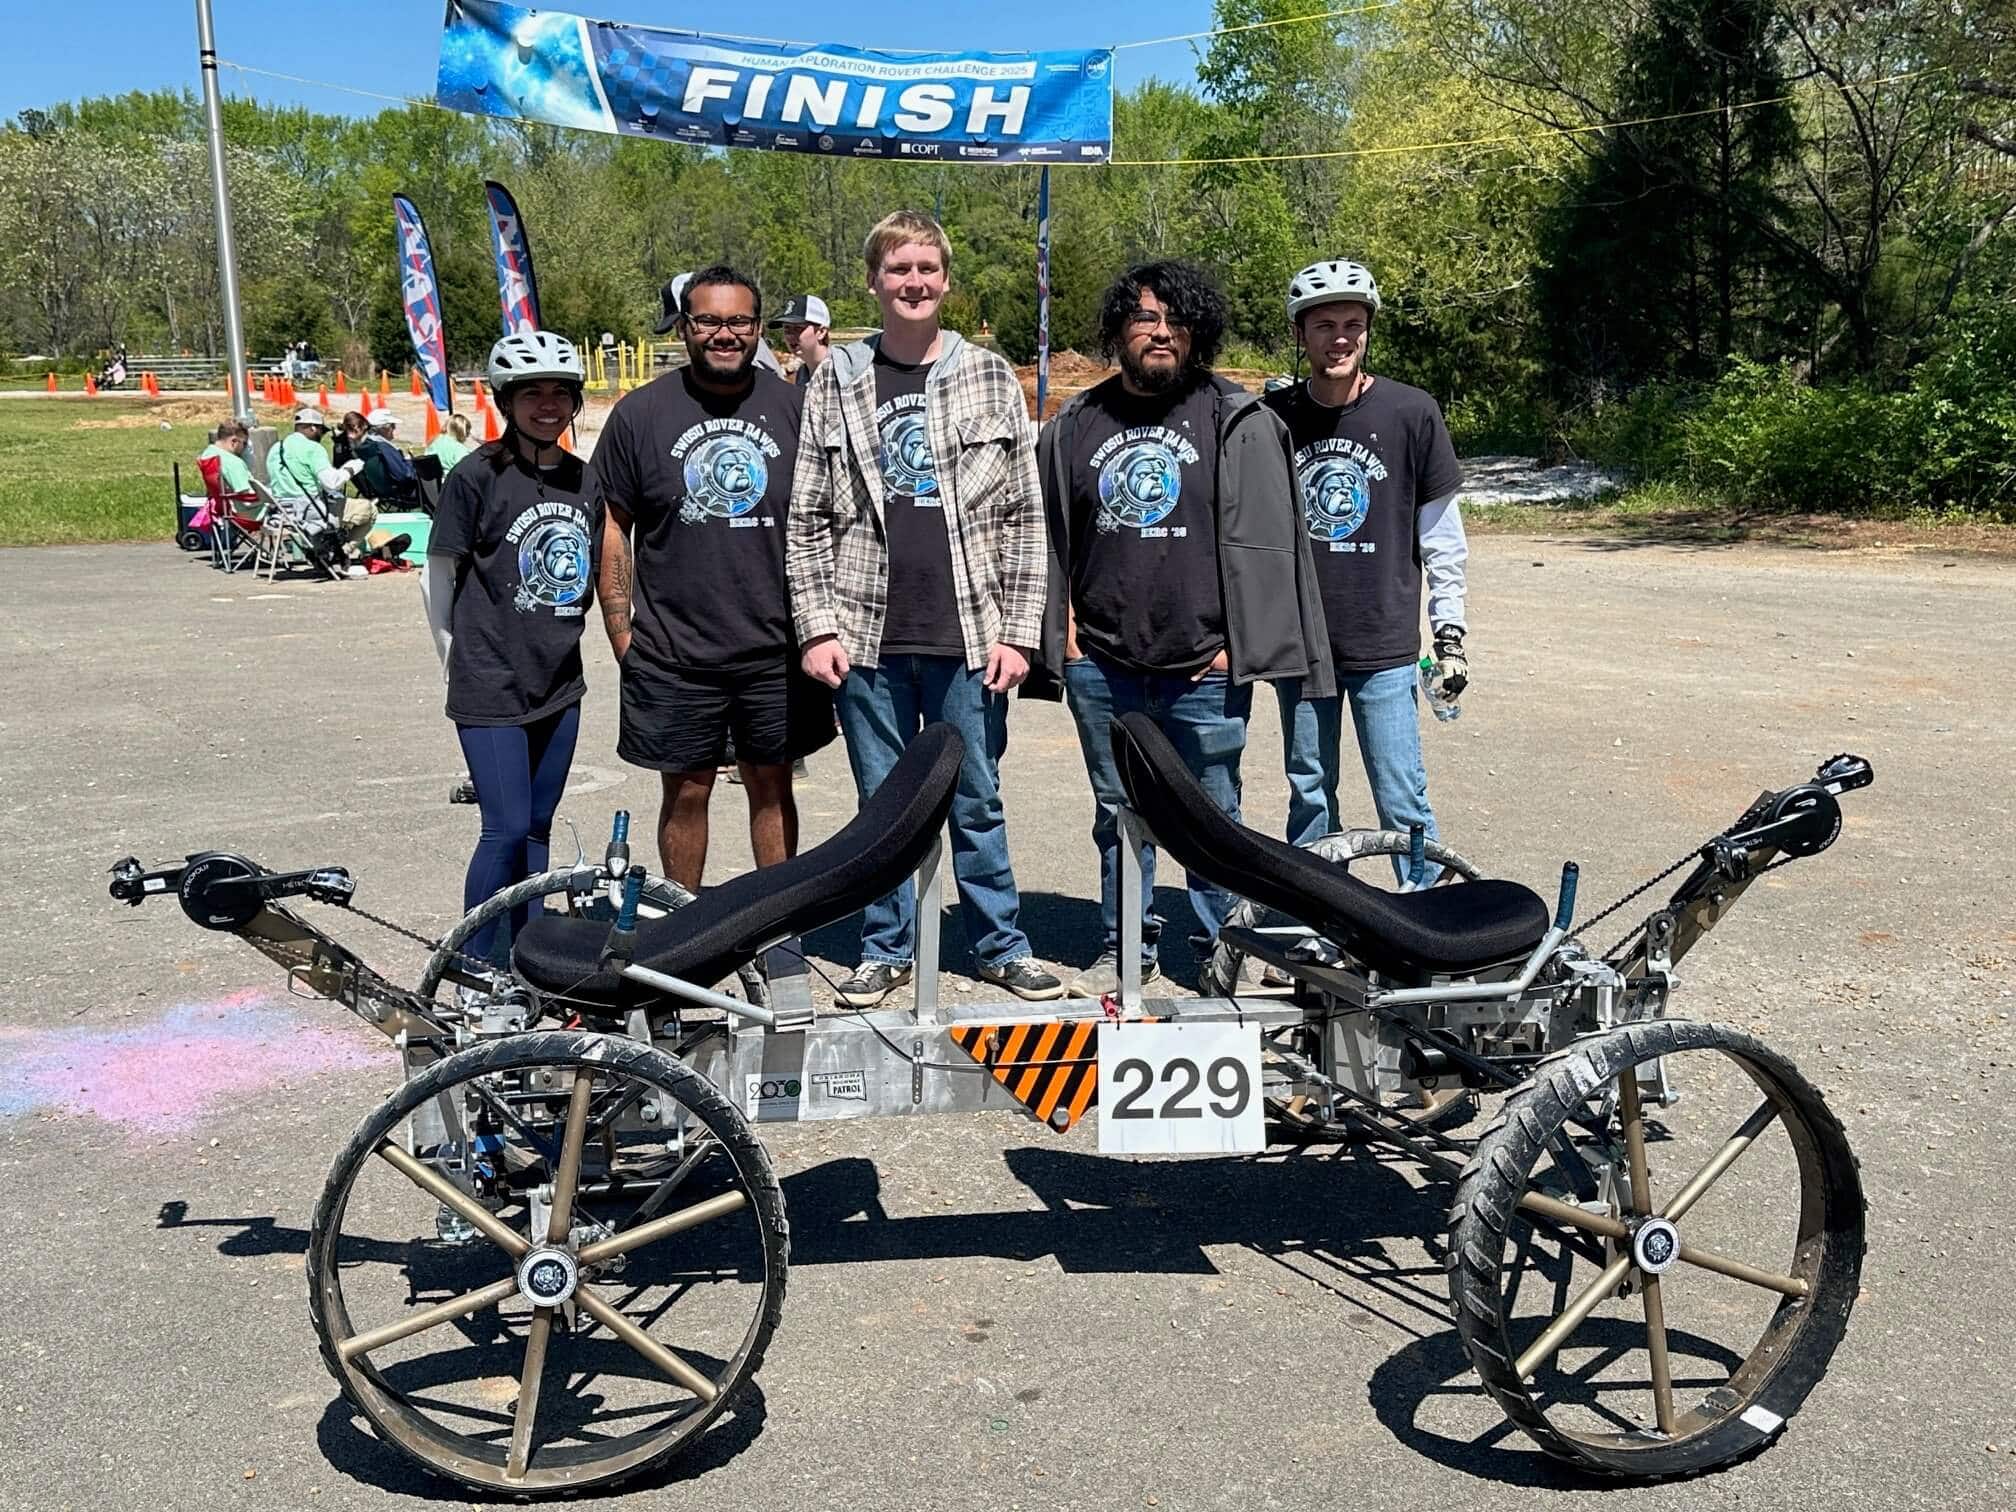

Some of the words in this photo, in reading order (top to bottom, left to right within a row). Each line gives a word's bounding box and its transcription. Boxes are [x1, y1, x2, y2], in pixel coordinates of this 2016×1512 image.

[741, 56, 789, 67] HUMAN
[878, 67, 921, 76] ROVER
[925, 63, 997, 75] CHALLENGE
[1000, 66, 1028, 75] 2025
[681, 66, 1032, 135] FINISH
[893, 393, 926, 410] ROVE
[670, 423, 705, 459] SWOSU
[704, 418, 745, 433] ROVER
[744, 422, 781, 458] DAWGS
[1089, 431, 1124, 469] SWOSU
[1125, 426, 1165, 441] ROVER
[1161, 428, 1200, 465] DAWGS
[1314, 438, 1353, 454] ROVER
[1351, 443, 1388, 481] DAWGS
[505, 506, 539, 545] SWOSU
[536, 502, 573, 518] ROVER
[833, 1084, 861, 1096] PATROL
[1112, 1056, 1251, 1119] 229
